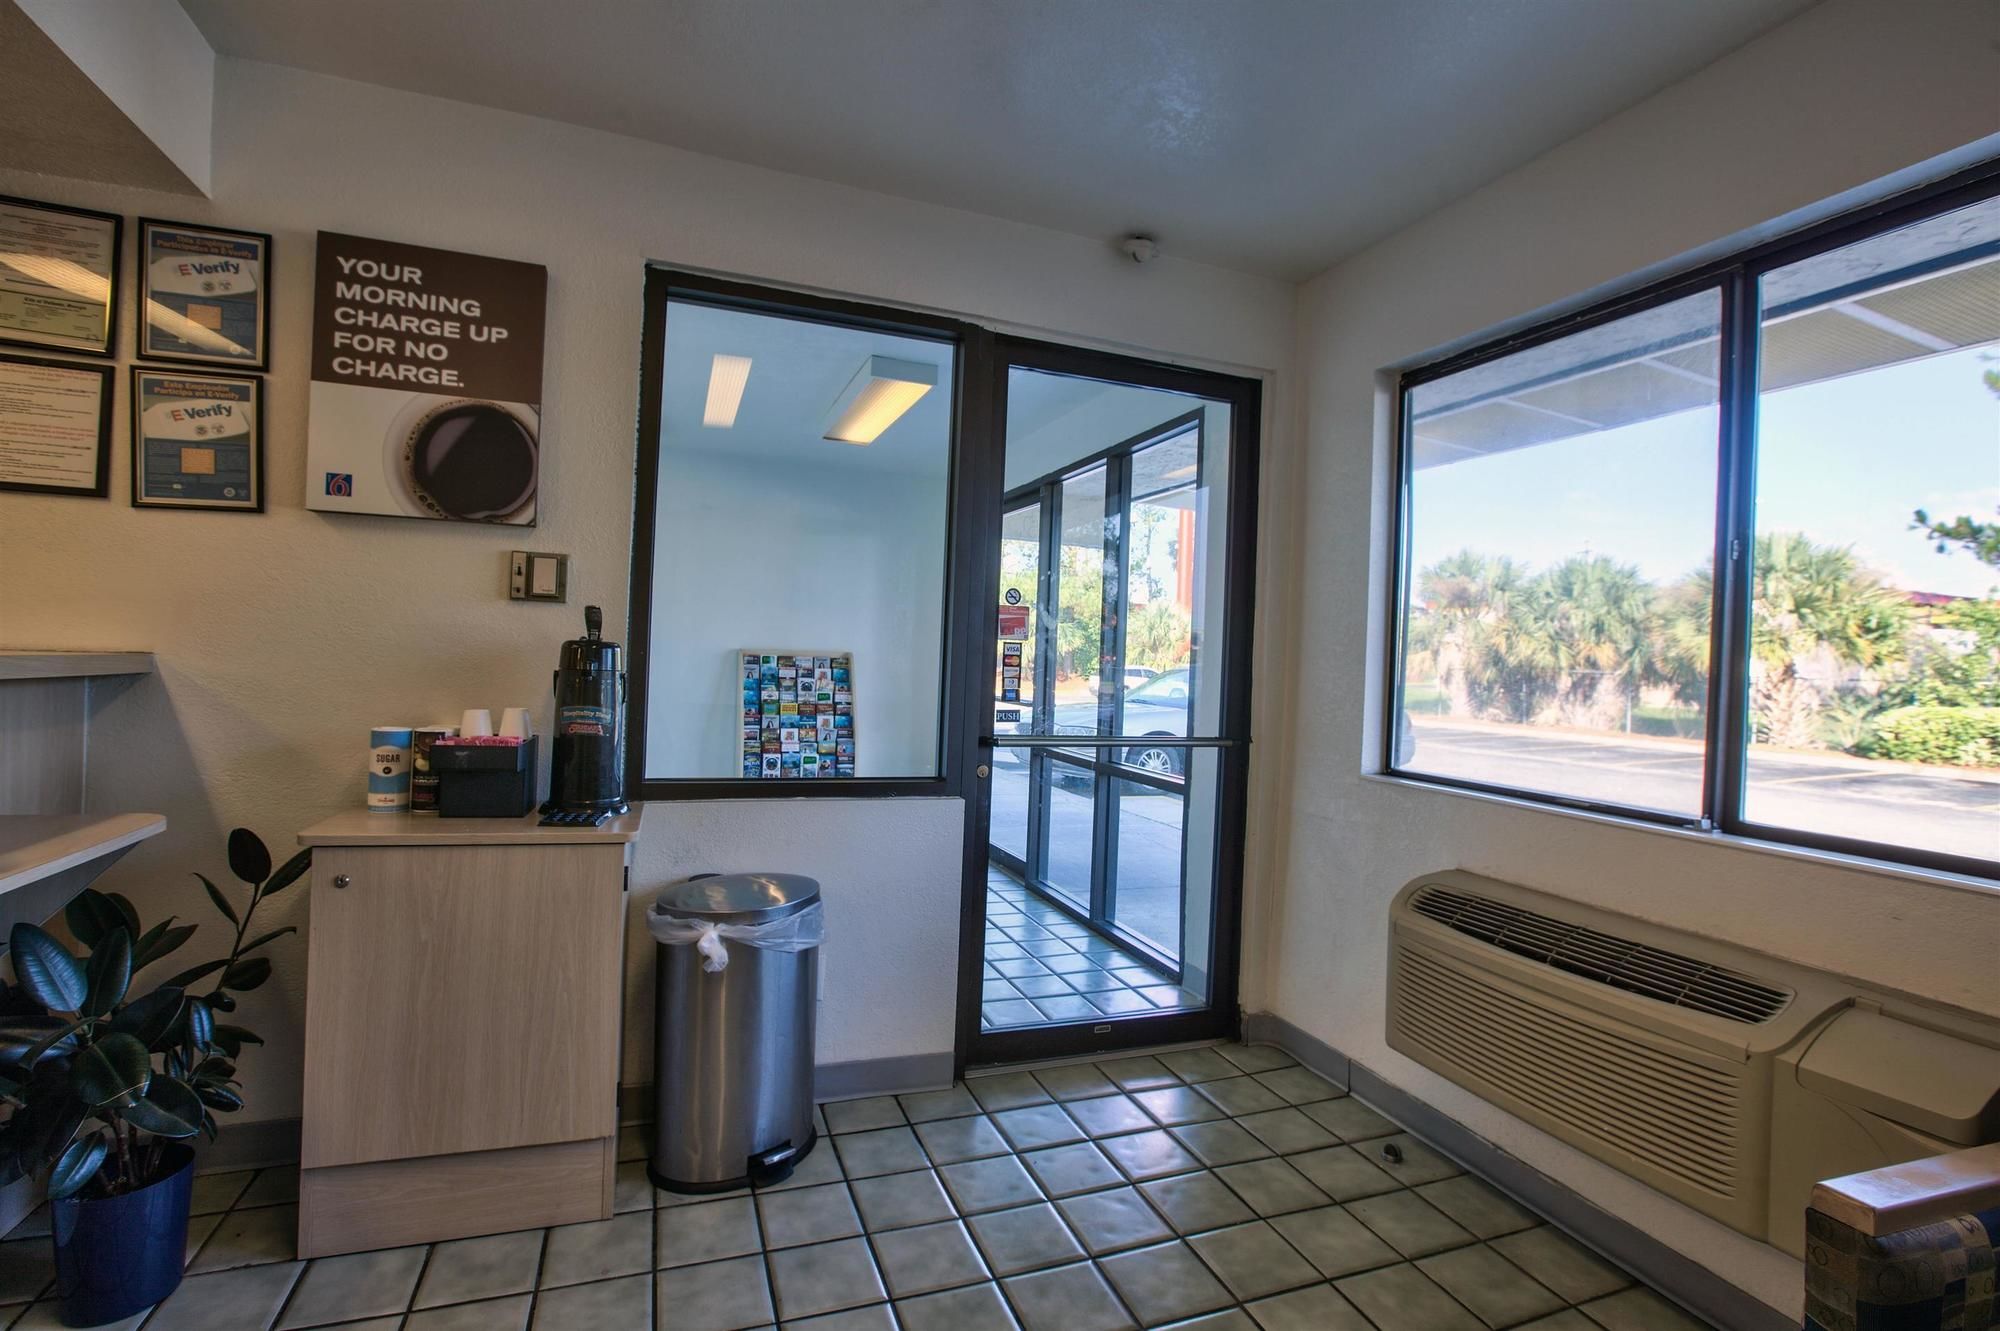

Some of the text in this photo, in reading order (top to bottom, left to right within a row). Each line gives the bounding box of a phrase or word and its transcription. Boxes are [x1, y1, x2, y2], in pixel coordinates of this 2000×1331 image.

[336, 255, 422, 285] YOUR
[335, 281, 481, 317] MORNING
[333, 307, 509, 343] CHARGE UP
[333, 331, 449, 361] FOR NO
[331, 356, 465, 388] CHARGE.
[997, 712, 1020, 721] PUSH
[376, 753, 401, 764] SUGAR
